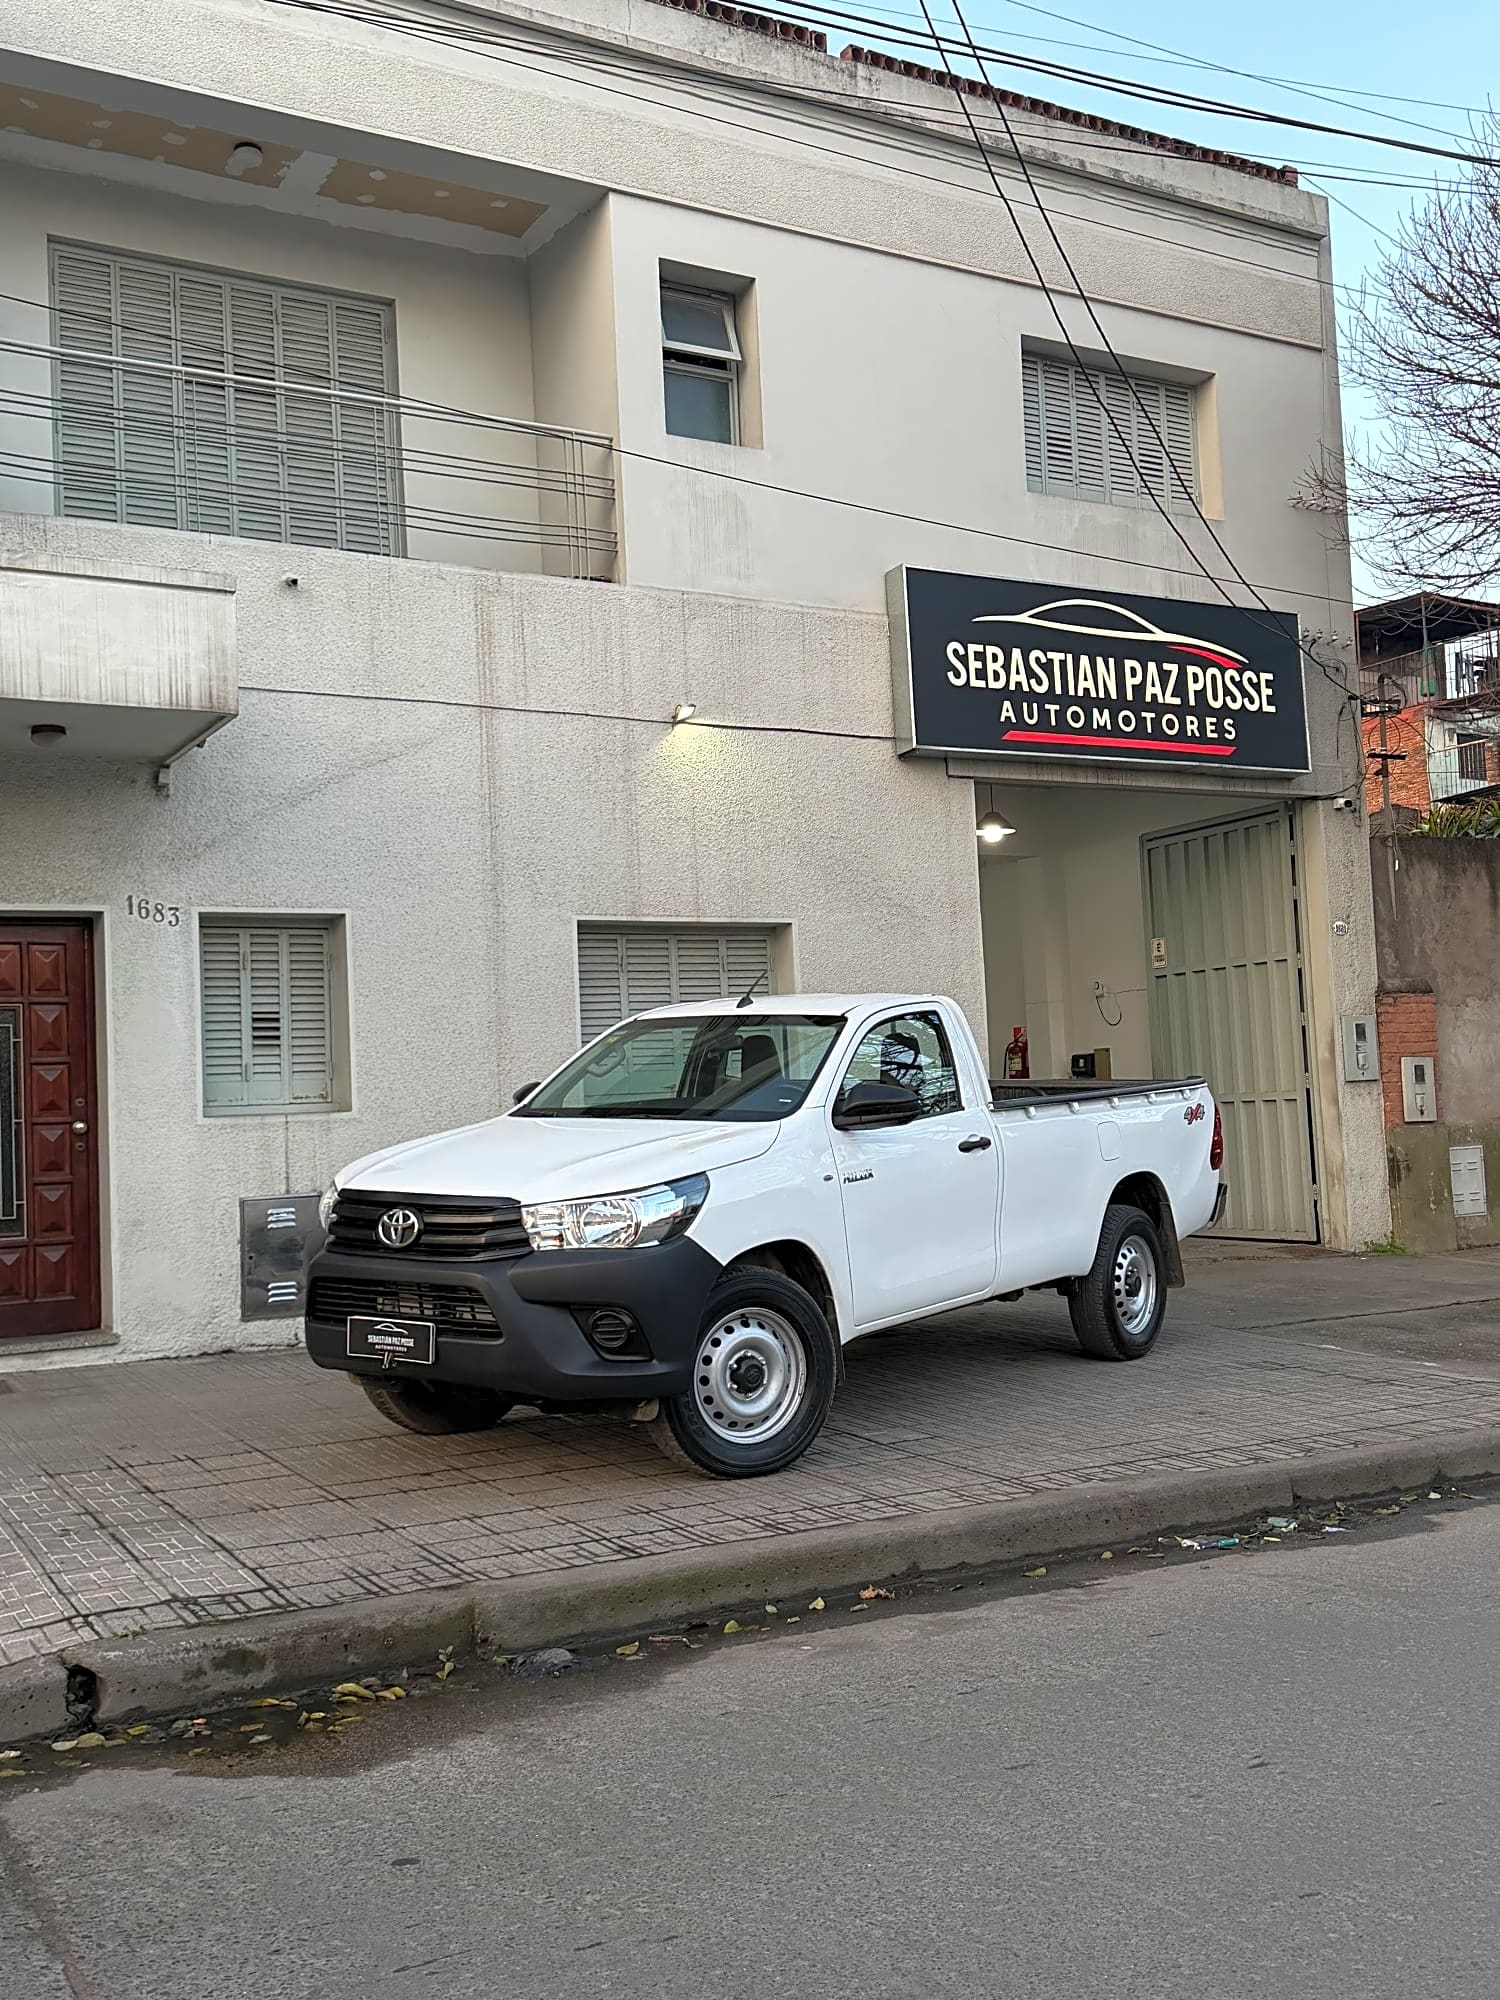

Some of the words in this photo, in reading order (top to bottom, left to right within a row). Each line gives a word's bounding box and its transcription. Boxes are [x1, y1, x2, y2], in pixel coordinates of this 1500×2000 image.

[945, 640, 1117, 701] SEBASTIAN
[1125, 658, 1182, 706] PAZ
[1187, 666, 1277, 714] POSSE
[1000, 700, 1237, 741] AUTOMOTORES
[126, 894, 180, 927] 1683
